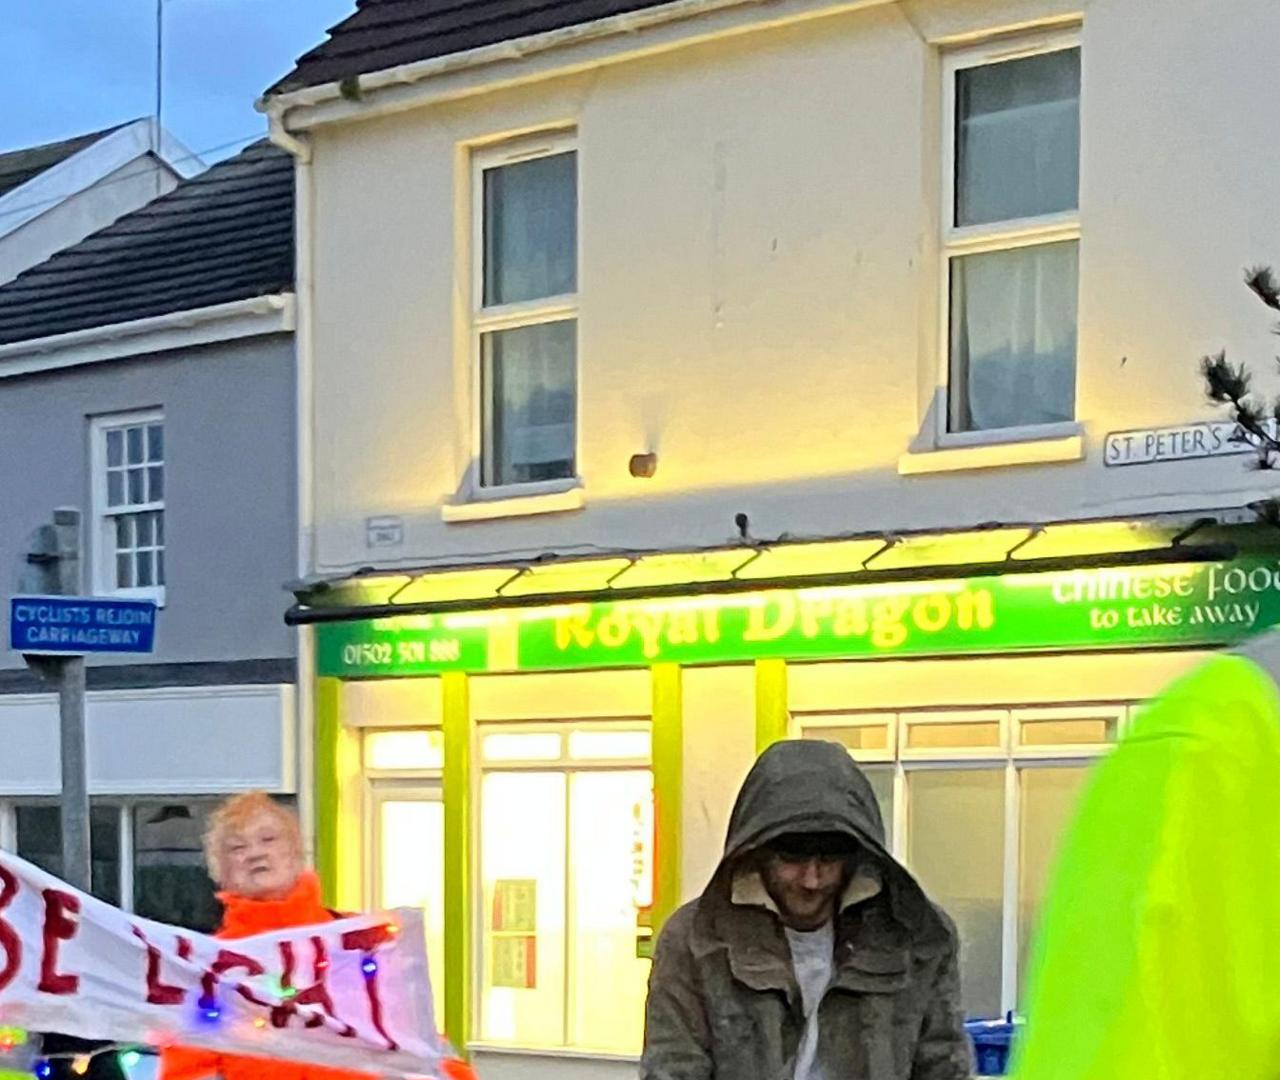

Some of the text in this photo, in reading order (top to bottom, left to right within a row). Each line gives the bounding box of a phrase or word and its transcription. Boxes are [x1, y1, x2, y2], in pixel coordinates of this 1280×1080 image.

[15, 605, 152, 625] CYCLISTS REJOIN
[554, 589, 995, 658] Royal Dragon
[1090, 601, 1260, 629] to take away
[27, 626, 141, 645] CARRIAGEWAY
[344, 643, 392, 665] 01502
